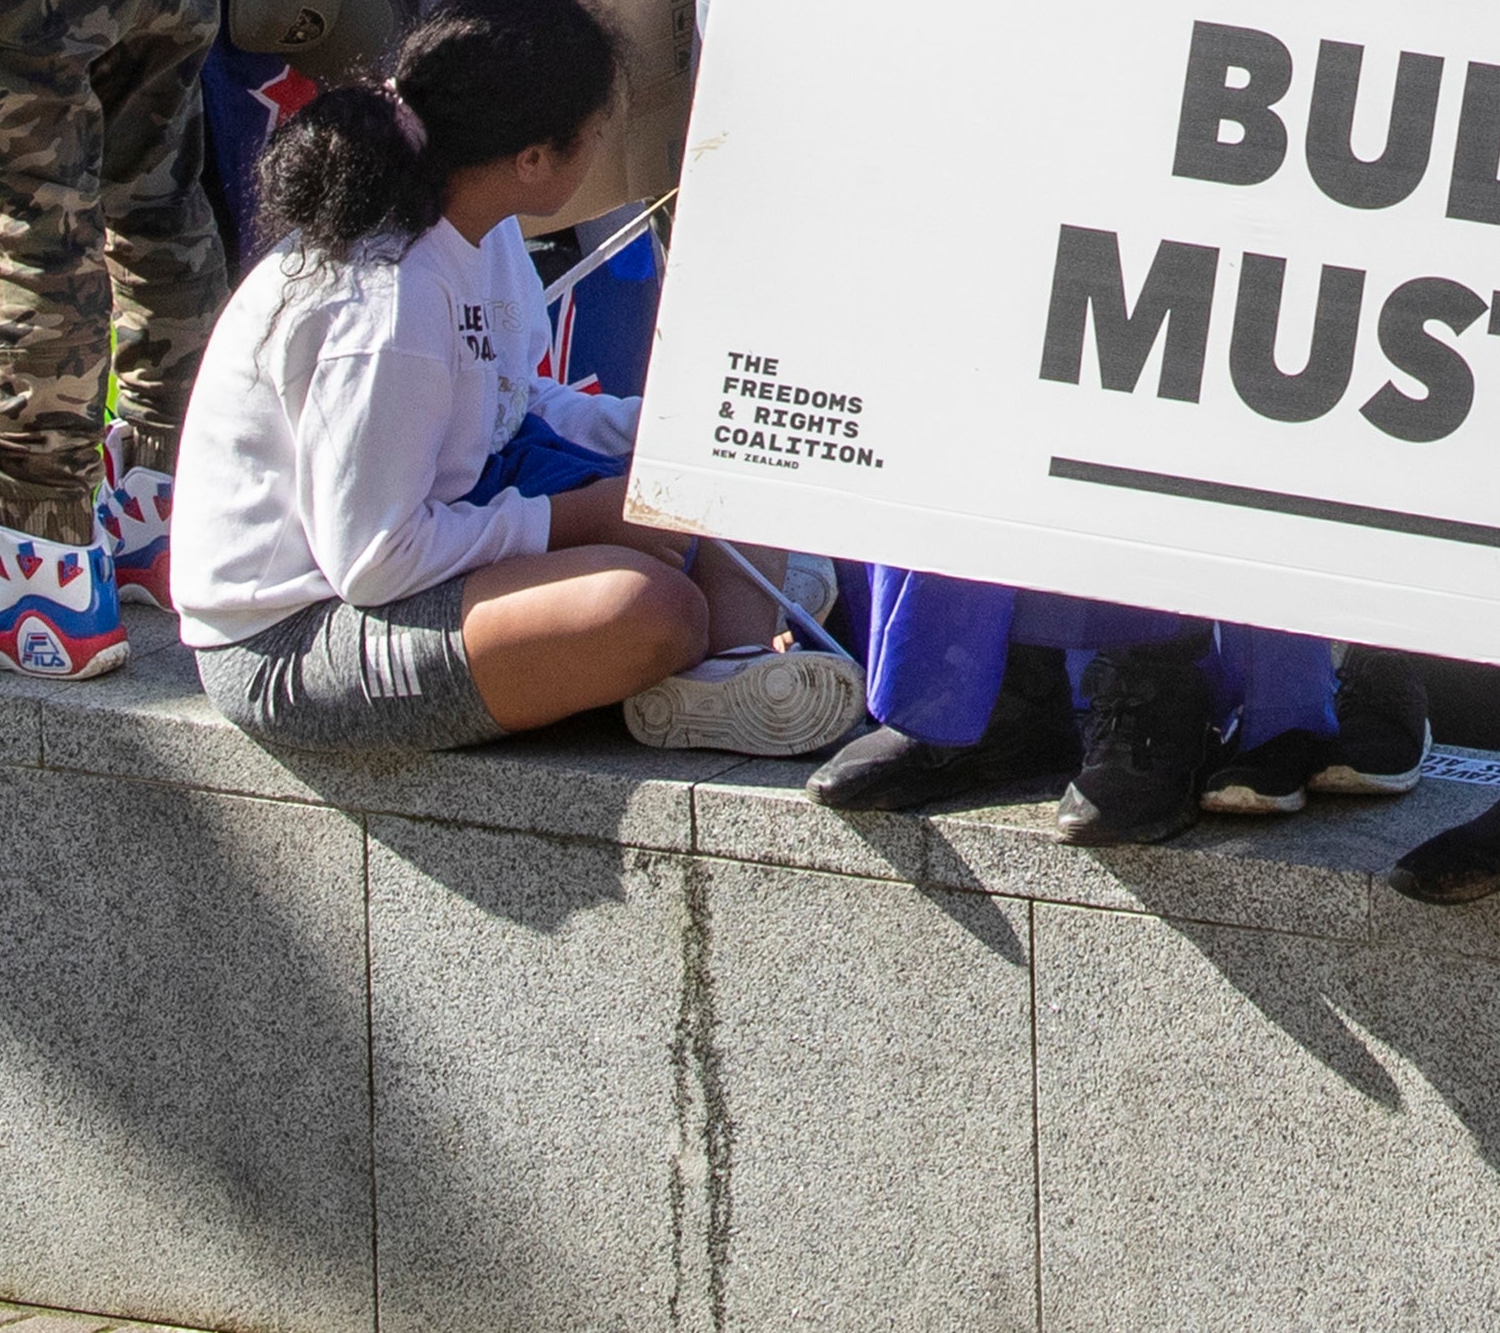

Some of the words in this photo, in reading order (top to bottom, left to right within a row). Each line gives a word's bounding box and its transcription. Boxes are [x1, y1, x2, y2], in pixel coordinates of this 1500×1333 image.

[728, 351, 779, 377] THE
[723, 376, 863, 414] FREEDOMS
[718, 401, 735, 420] &
[754, 406, 859, 439] RIGHTS
[712, 449, 737, 459] NEW
[744, 453, 799, 470] ZEALAND
[714, 425, 884, 469] COALITION.
[22, 652, 66, 669] FILA
